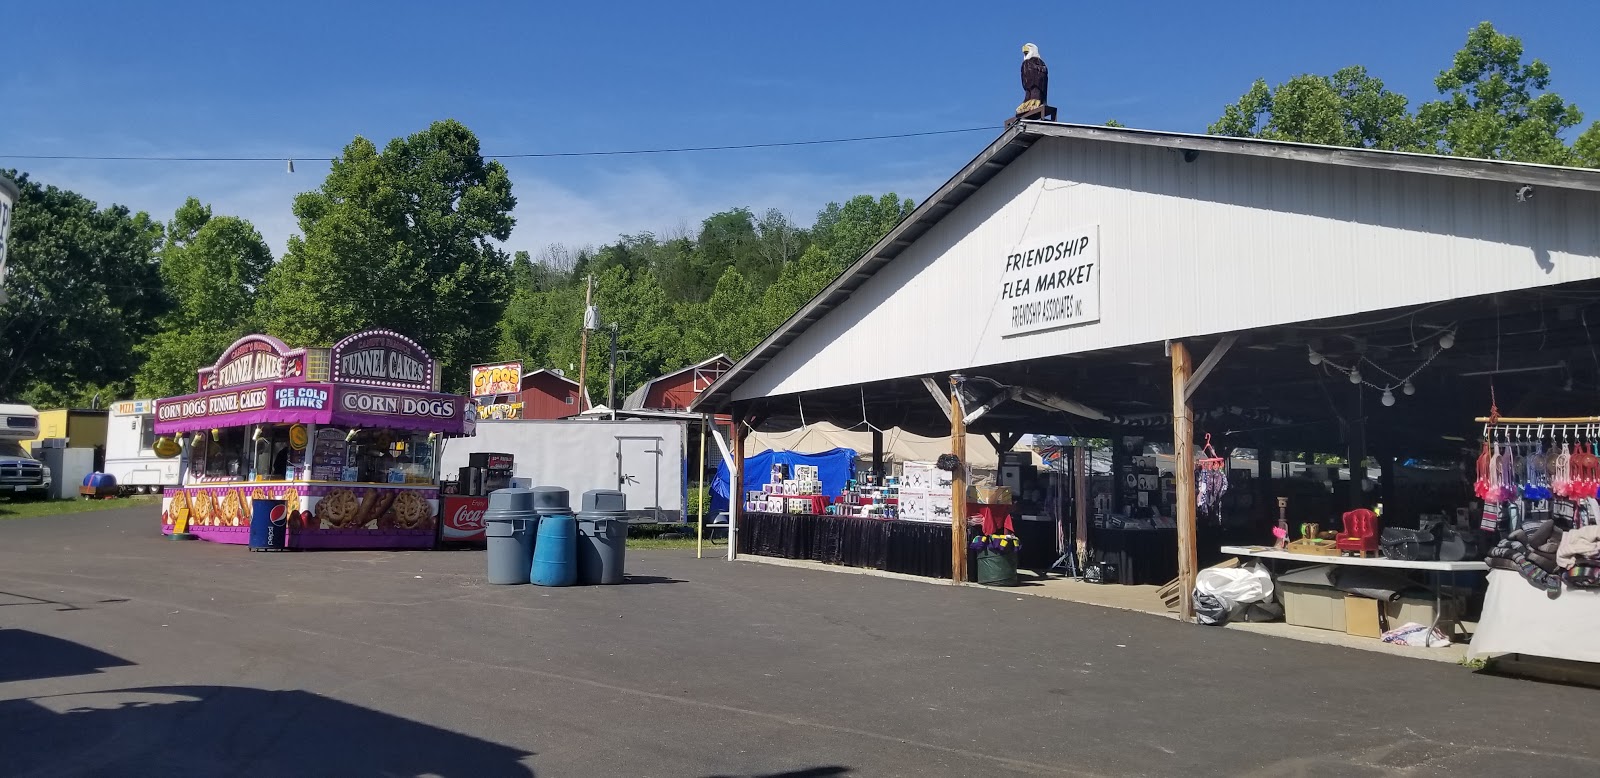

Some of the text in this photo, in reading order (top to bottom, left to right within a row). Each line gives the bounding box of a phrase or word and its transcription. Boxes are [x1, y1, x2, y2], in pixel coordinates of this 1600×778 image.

[1005, 236, 1089, 273] FRIENDSHIP
[1001, 263, 1094, 300] FLEA MARKET
[1011, 300, 1042, 328] FRIENDSHIP
[1042, 294, 1074, 323] ASSOCIATES
[219, 353, 253, 386] FUNNEL
[254, 352, 282, 380] CAKES
[341, 349, 424, 382] FUNNEL CAKES
[474, 368, 519, 387] GYROS
[119, 403, 134, 414] PIZZA
[158, 404, 181, 420] CORN
[182, 400, 207, 417] DOGS
[209, 394, 239, 415] FUNNEL
[240, 390, 267, 409] CAKES
[275, 387, 328, 401] ICE COLD
[279, 397, 323, 409] DRINKS
[343, 393, 400, 413] CORN
[401, 398, 456, 418] DOGS
